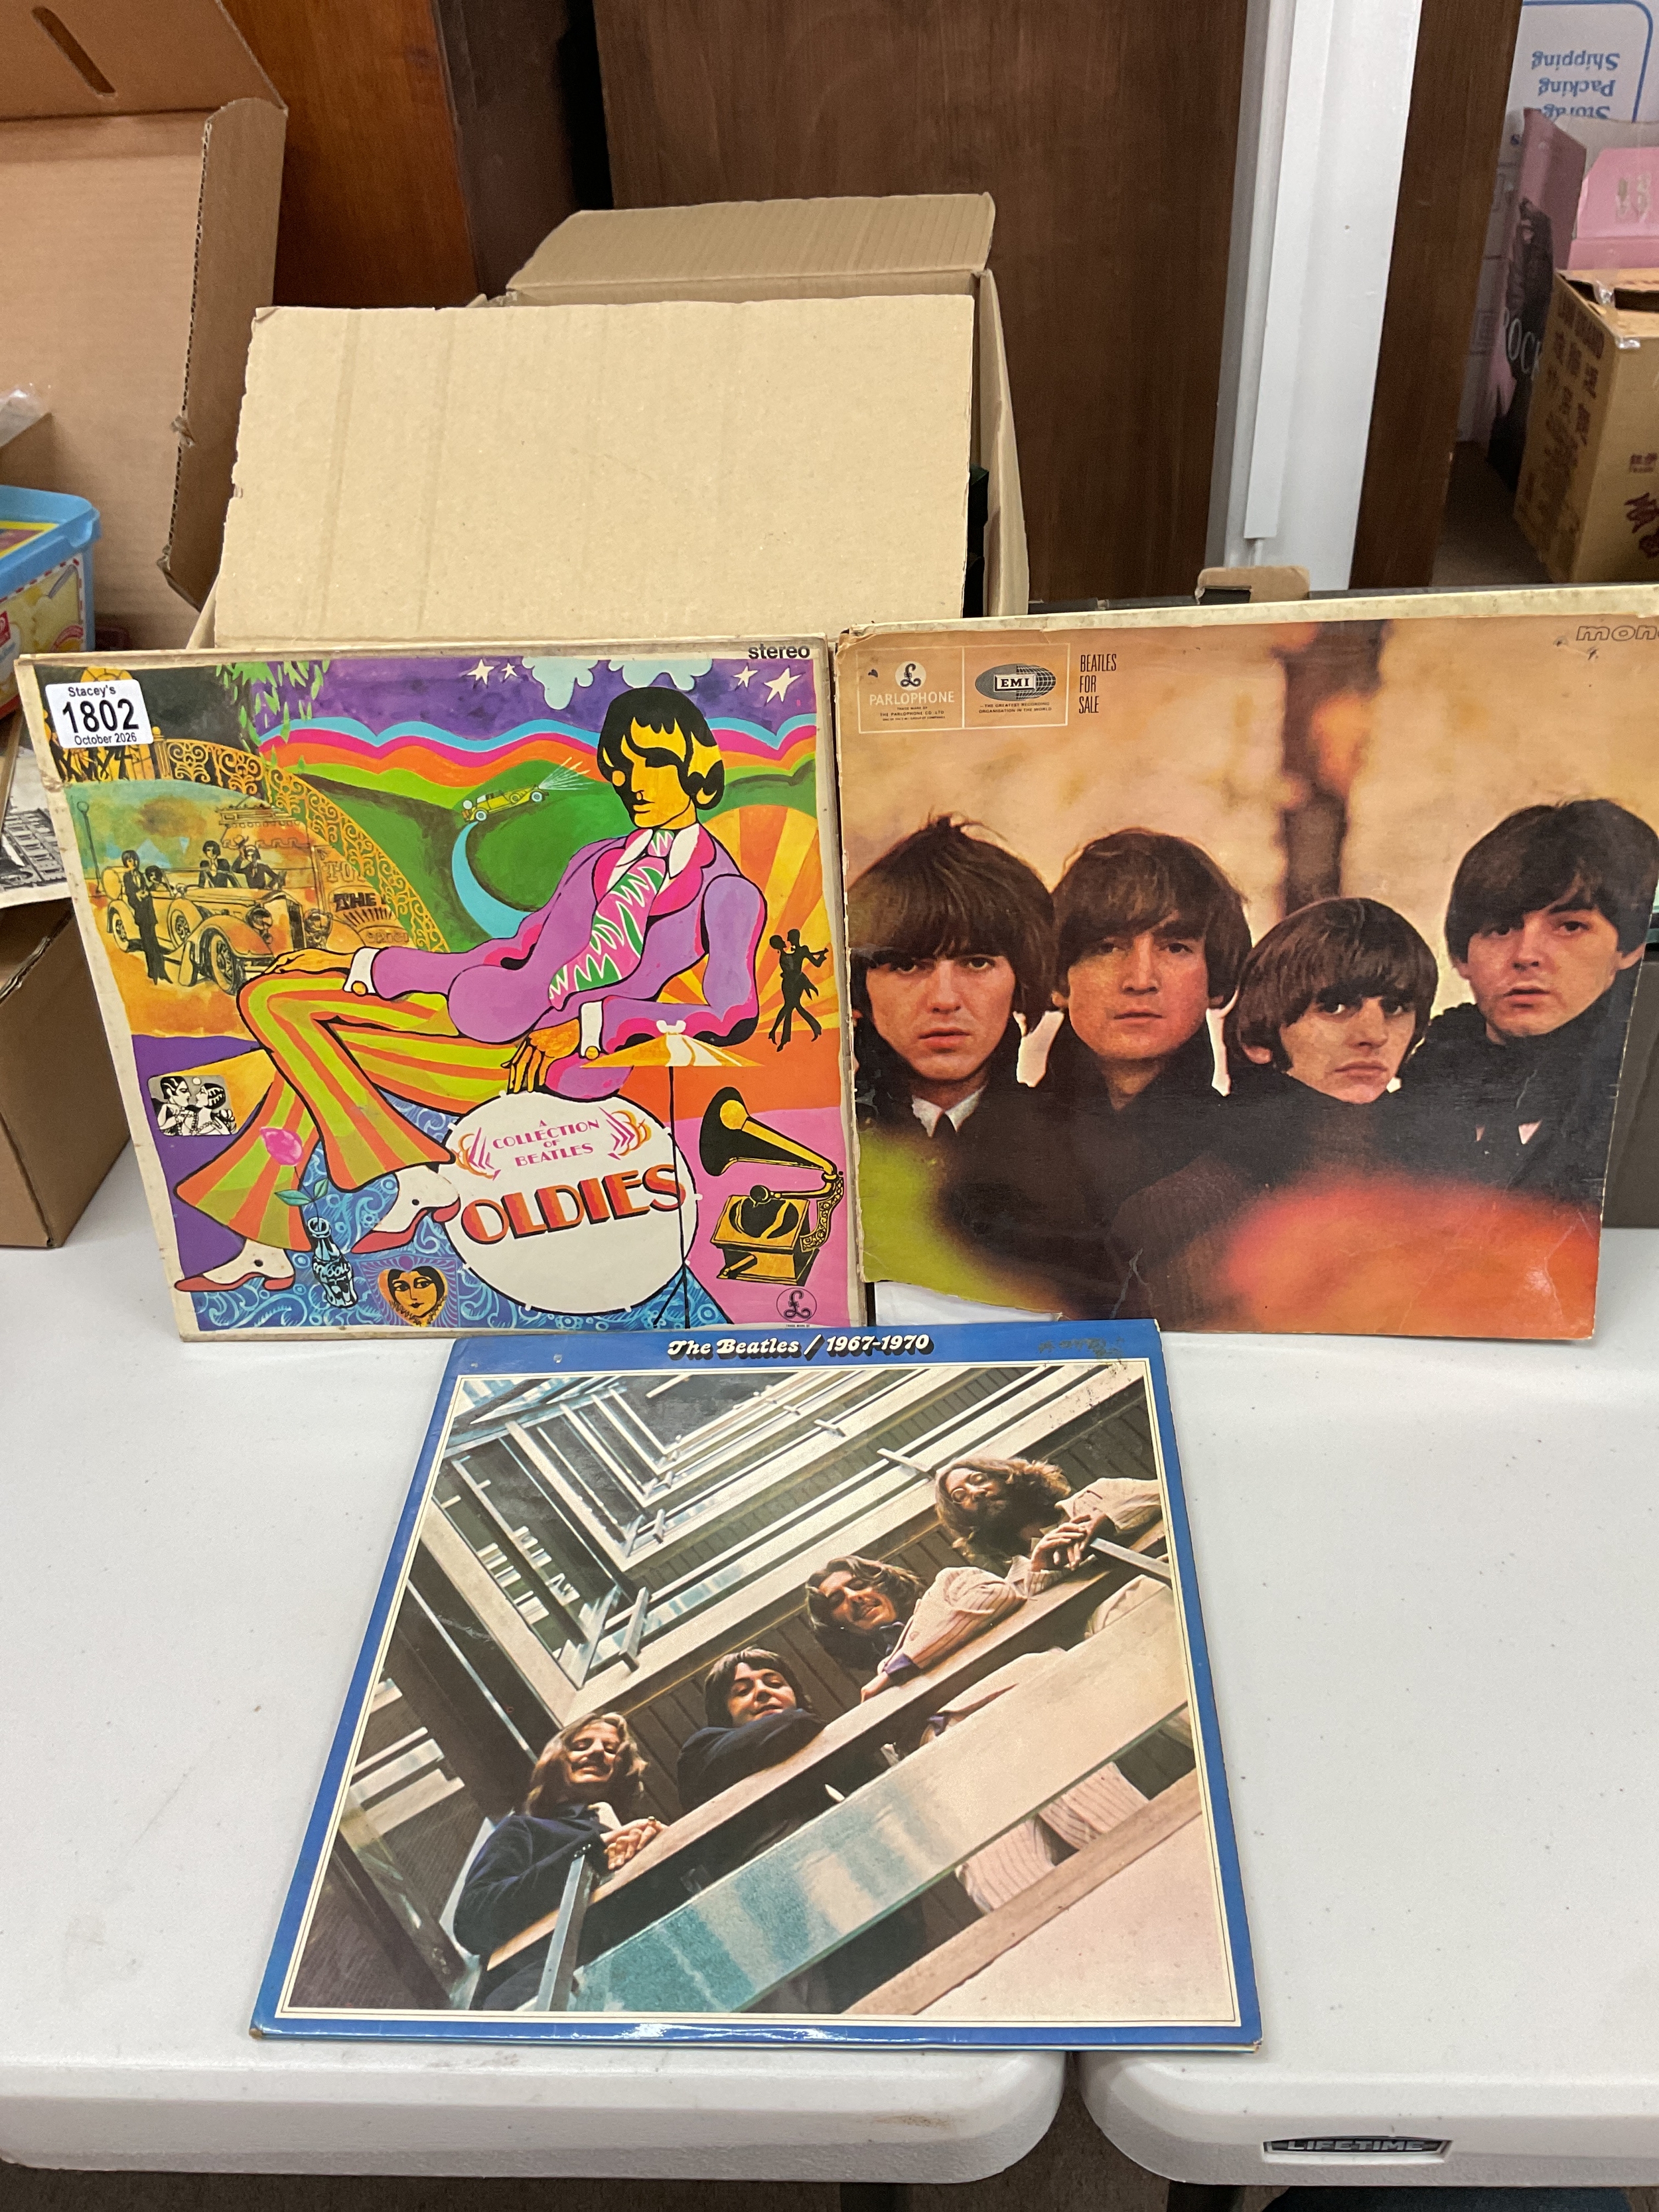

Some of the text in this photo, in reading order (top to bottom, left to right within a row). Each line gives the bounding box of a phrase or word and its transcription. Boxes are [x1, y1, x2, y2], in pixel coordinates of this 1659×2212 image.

[1532, 50, 1621, 70] Shipping
[1538, 78, 1616, 97] Packing
[1542, 104, 1611, 119] Storag
[1575, 625, 1659, 642] mon
[748, 643, 810, 659] stereo
[1080, 653, 1117, 672] BEATLES
[68, 685, 117, 698] Stacey's
[1001, 678, 1029, 688] EMI
[1079, 675, 1096, 693] FOR
[869, 691, 955, 706] PARLOPHONE
[1078, 696, 1100, 713] SALE
[62, 698, 139, 733] 1802
[74, 732, 137, 745] October 2026
[539, 1120, 547, 1128] A
[492, 1120, 601, 1149] COLLECTION
[543, 1139, 561, 1148] OF
[514, 1143, 594, 1167] BEATLES
[461, 1164, 687, 1245] OLDIES
[667, 1339, 712, 1357] The
[716, 1337, 800, 1355] Beatles
[826, 1333, 930, 1353] 1967-1970
[1287, 2140, 1425, 2151] LIFETIME
